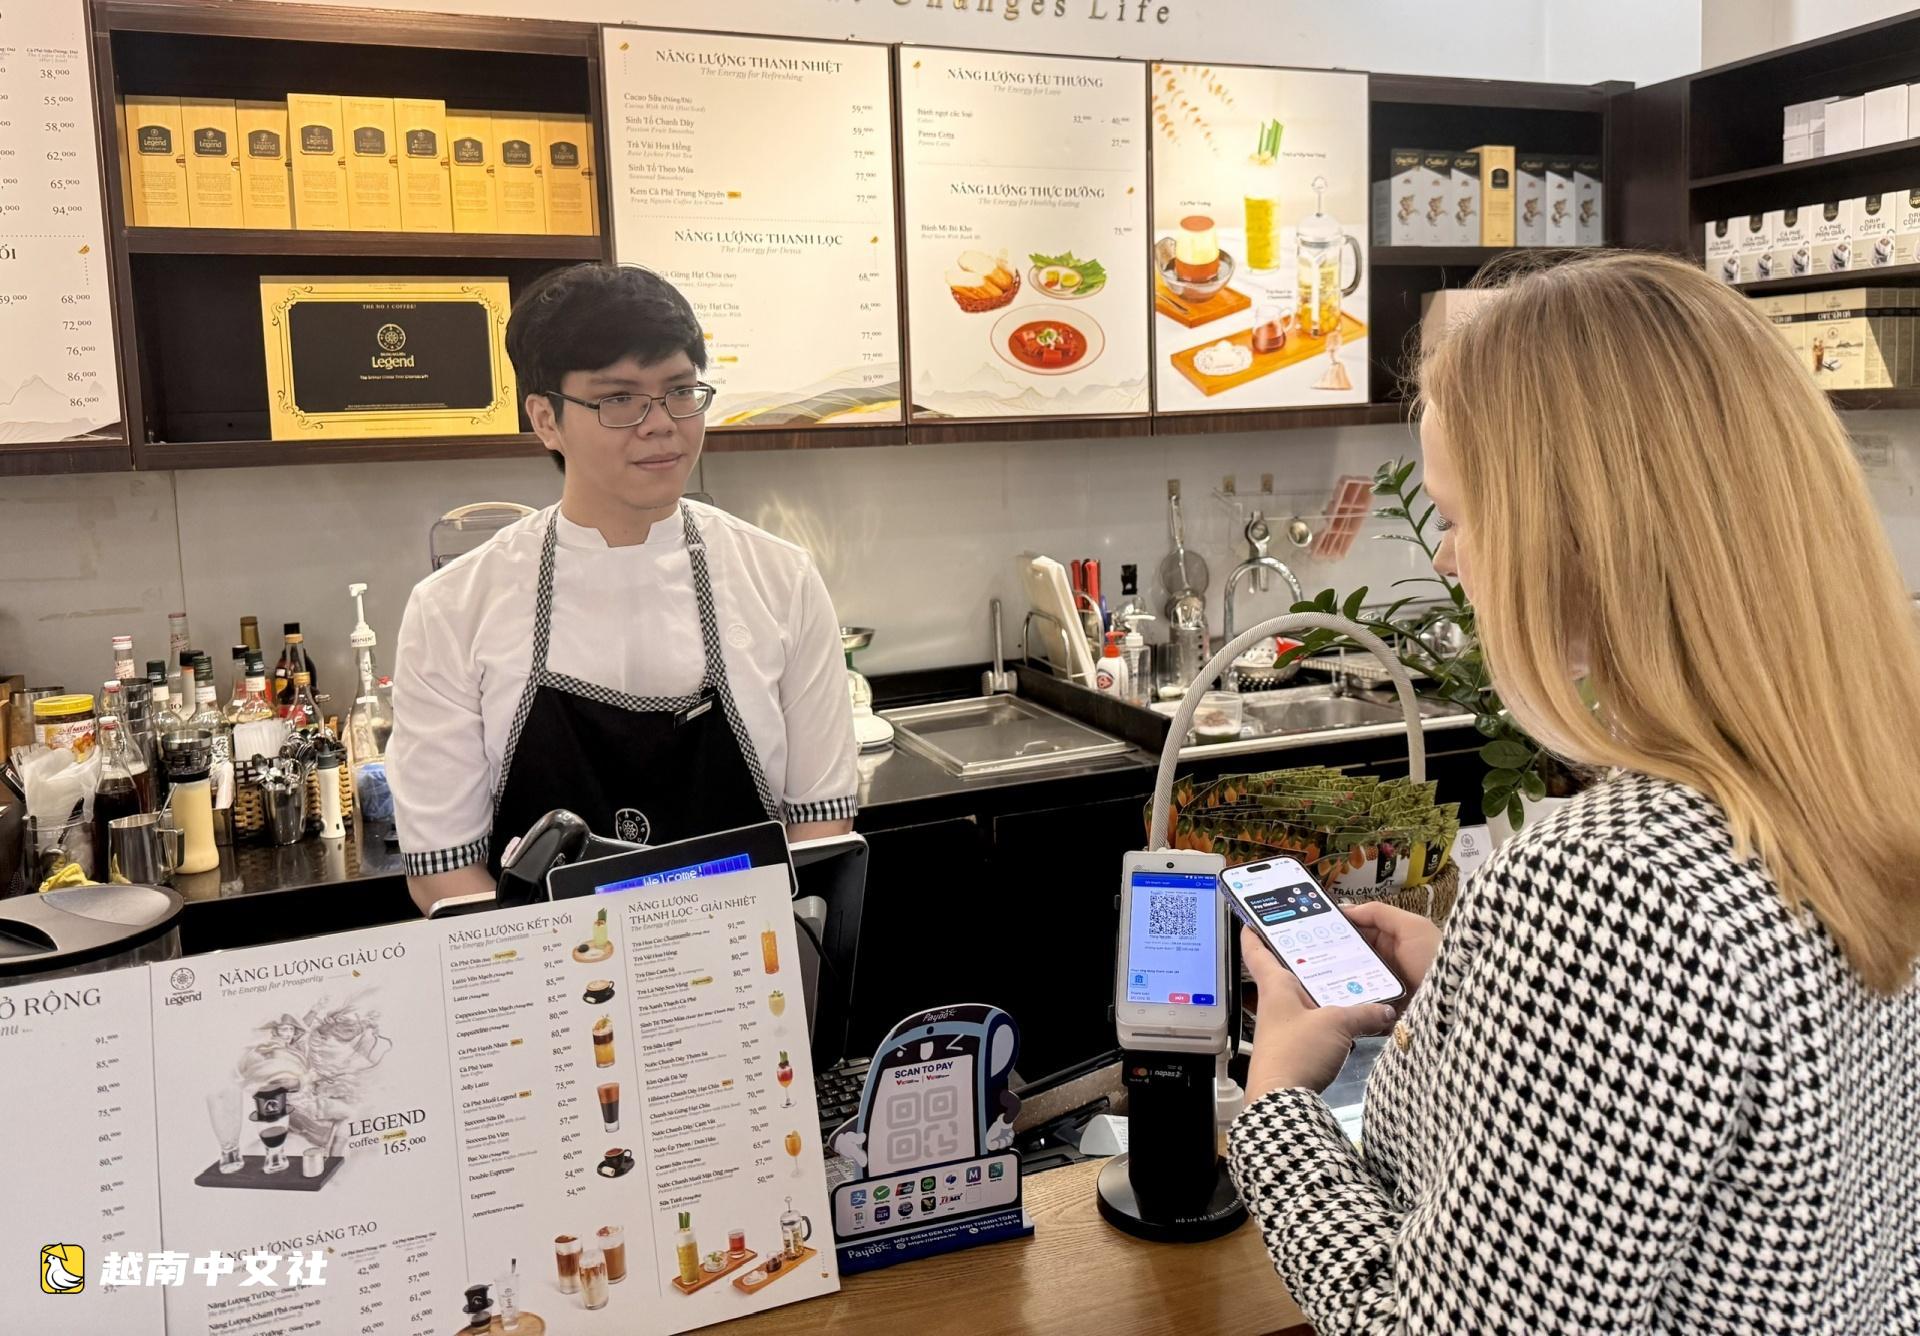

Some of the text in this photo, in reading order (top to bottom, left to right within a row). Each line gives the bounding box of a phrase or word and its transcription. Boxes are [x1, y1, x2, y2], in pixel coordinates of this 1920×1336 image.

[1088, 2, 1170, 24] Life
[750, 57, 798, 70] THANH
[801, 60, 843, 74] NHIỆT
[40, 69, 69, 79] 38,000
[700, 67, 803, 82] The Energy for Refreshing
[1027, 72, 1051, 85] YÊU
[993, 85, 1006, 93] The
[1008, 86, 1032, 95] Energy
[1033, 87, 1044, 95] for
[44, 96, 73, 106] 55,000
[45, 122, 74, 132] 58,000
[306, 137, 329, 146] Legend
[47, 152, 76, 161] 62,000
[50, 179, 80, 190] 65,000
[992, 199, 1017, 207] Energy
[1019, 199, 1029, 207] for
[52, 206, 82, 216] 94,000
[1859, 223, 1886, 232] COFFEE
[766, 233, 814, 244] THANH
[817, 234, 843, 246] LỌC
[736, 246, 764, 255] Energy
[766, 246, 778, 255] for
[63, 321, 91, 331] 72,000
[372, 355, 414, 369] Legend
[67, 372, 96, 382] 86,000
[643, 866, 704, 887] Welcome!
[1333, 887, 1372, 896] TRÁI CÂY
[628, 894, 699, 913] NĂNG LƯỢNG
[629, 911, 669, 925] THANH
[672, 906, 693, 918] LỌC
[701, 899, 723, 912] GIẢI
[725, 896, 757, 910] NHIỆT
[449, 914, 572, 944] NĂNG LƯỢNG KẾT NỐI
[642, 921, 664, 931] Energy
[449, 943, 461, 951] The
[462, 941, 484, 950] Energy
[485, 938, 494, 947] for
[543, 942, 562, 952] 91,000
[219, 942, 406, 987] NĂNG LƯỢNG GIÀU CÓ
[221, 974, 324, 998] The Energy for Prosperity
[546, 976, 565, 986] 85,000
[24, 988, 101, 1016] RỘNG
[165, 992, 202, 1006] Legend
[549, 1010, 568, 1020] 80,000
[923, 1012, 949, 1022] Payoo
[96, 1034, 119, 1045] 91,000
[553, 1046, 572, 1055] 80,000
[895, 1067, 920, 1079] SCAN
[922, 1065, 935, 1073] TO
[936, 1062, 954, 1072] PAY
[97, 1082, 120, 1094] 80,000
[556, 1079, 575, 1089] 75,000
[349, 1109, 426, 1137] LEGEND
[560, 1115, 579, 1124] 57,000
[98, 1131, 122, 1143] 60,000
[349, 1136, 379, 1150] coffee
[384, 1135, 427, 1156] 165,000
[563, 1150, 582, 1160] 60,000
[100, 1181, 124, 1192] 80,000
[566, 1186, 586, 1196] 54,000
[306, 1221, 378, 1246] SÁNG TẠO
[406, 1252, 428, 1264] 47,000
[848, 1247, 882, 1259] Payoo
[357, 1262, 380, 1276] 42,000
[410, 1290, 431, 1302] 61,000
[360, 1302, 382, 1315] 56,000
